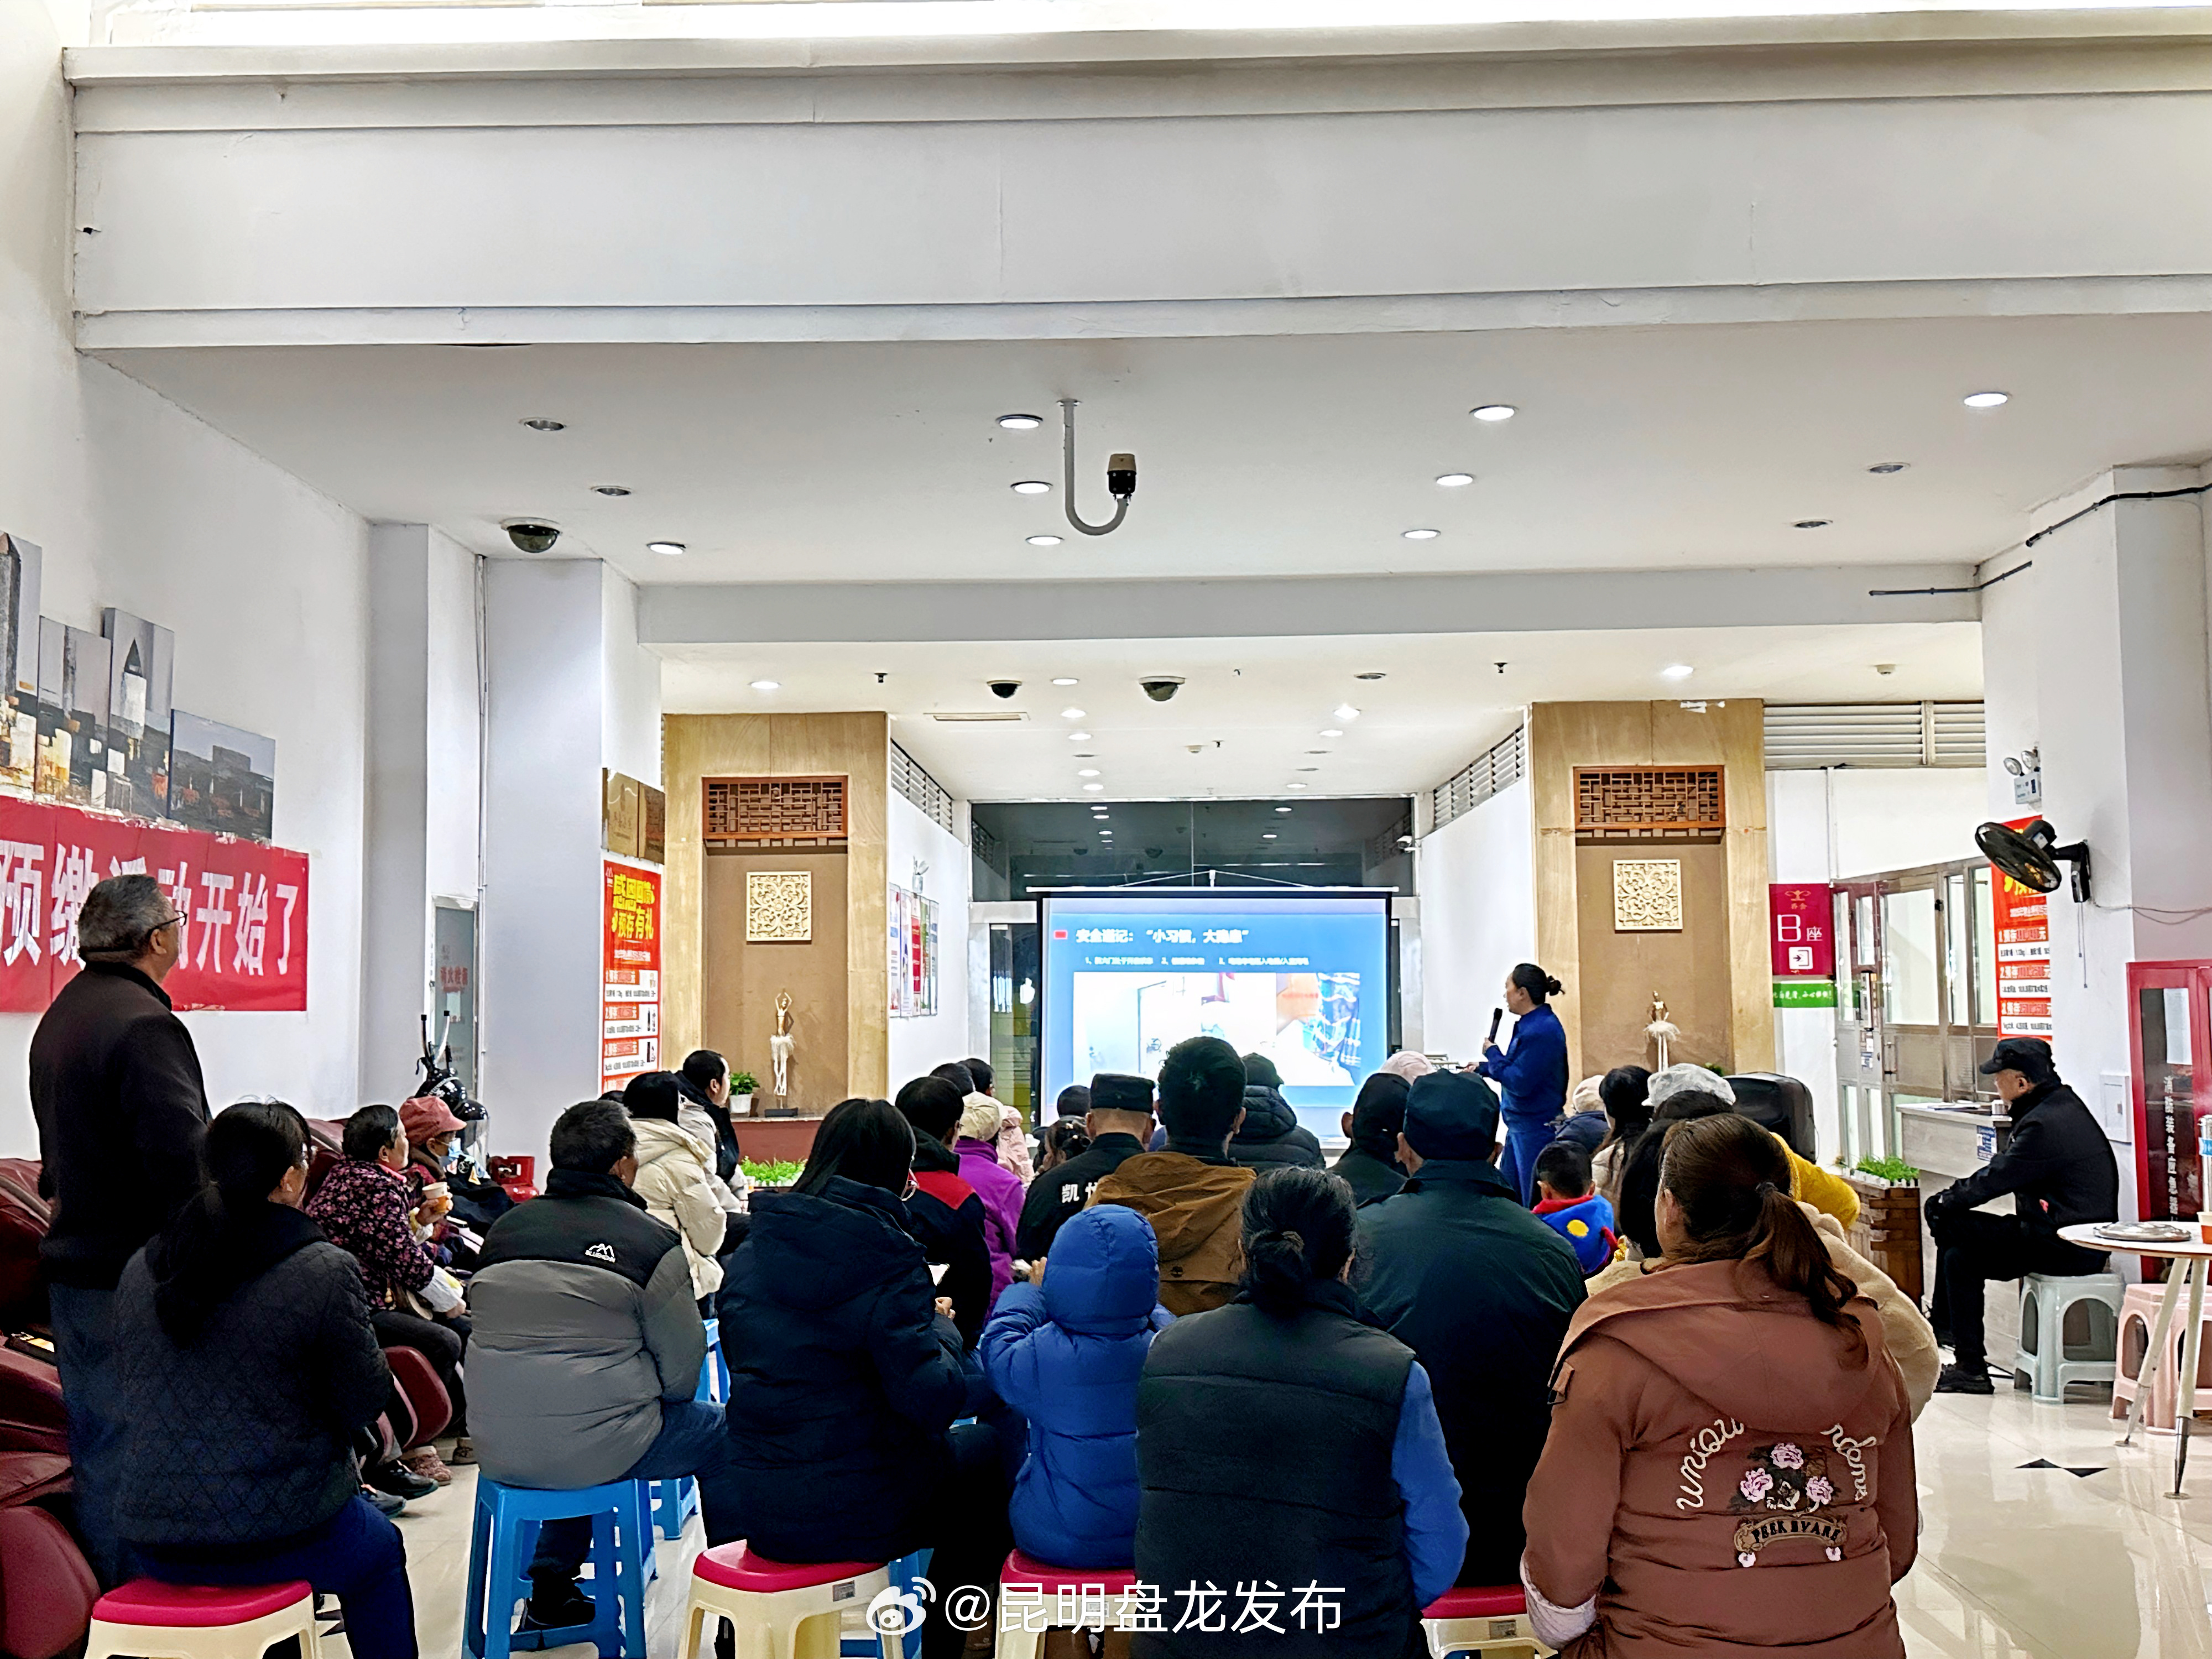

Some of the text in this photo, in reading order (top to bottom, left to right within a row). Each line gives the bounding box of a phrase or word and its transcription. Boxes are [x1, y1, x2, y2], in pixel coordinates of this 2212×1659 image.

[0, 839, 299, 976] 预缴动开始了
[1751, 1520, 1788, 1543] PEEK
